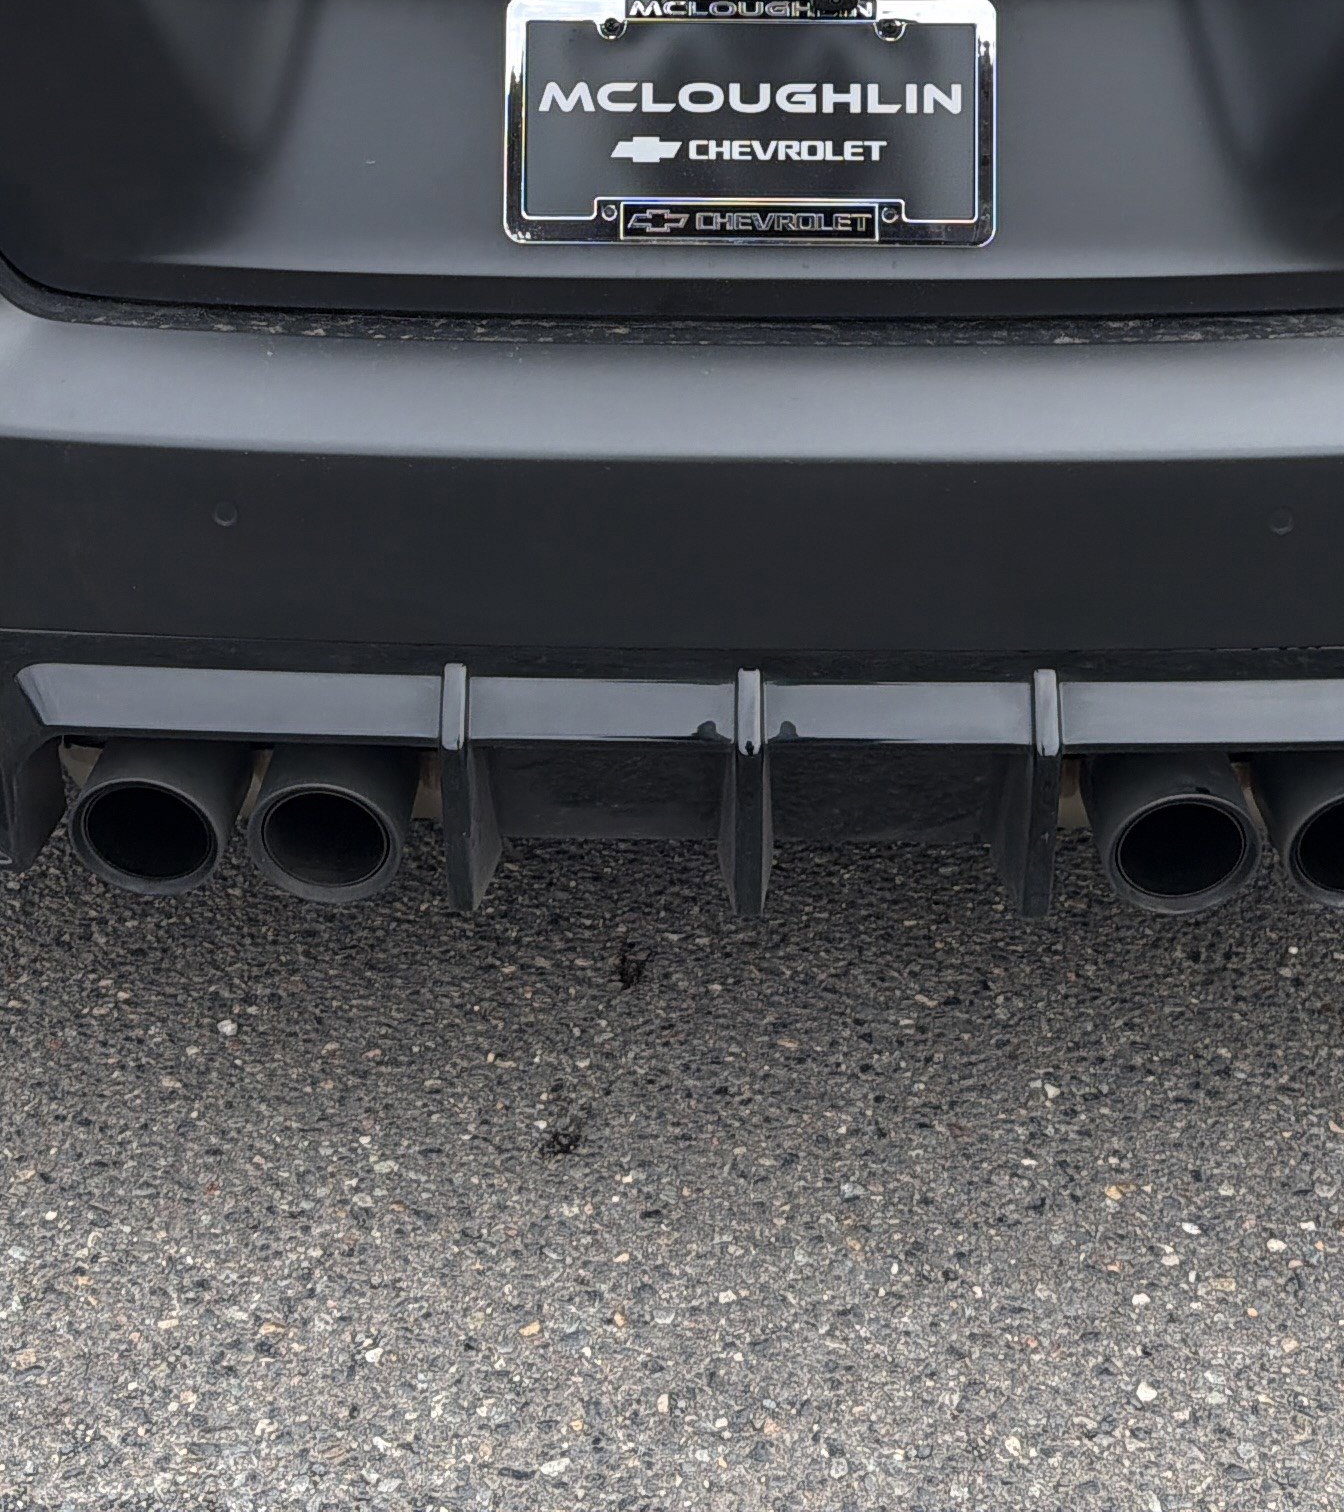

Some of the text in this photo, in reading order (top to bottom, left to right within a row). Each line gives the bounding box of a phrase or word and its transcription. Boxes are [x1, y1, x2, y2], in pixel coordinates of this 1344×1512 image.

[538, 81, 963, 115] MCLOUGHLIN
[688, 139, 888, 162] CHEVROLET
[695, 211, 872, 233] CHEVROLET
